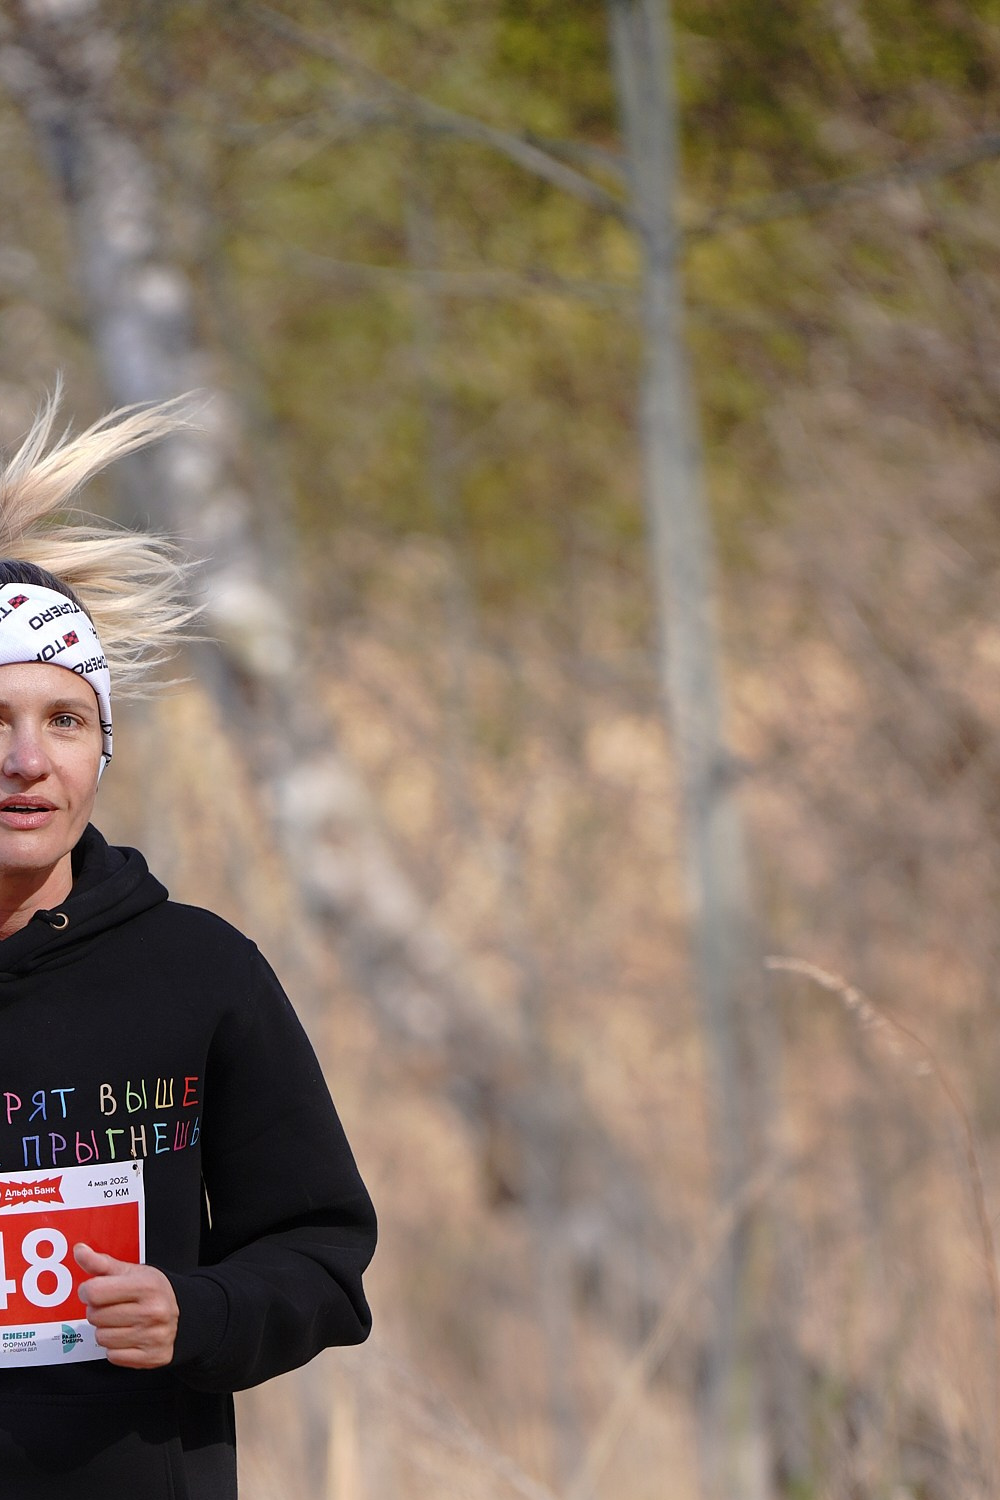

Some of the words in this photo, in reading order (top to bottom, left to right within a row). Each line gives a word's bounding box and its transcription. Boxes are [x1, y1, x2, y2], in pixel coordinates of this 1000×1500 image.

[99, 1076, 200, 1116] ВЫШЕ
[21, 1116, 200, 1168] ПРЫГНЕШЬ
[87, 1180, 94, 1188] 4
[109, 1176, 129, 1185] 2025
[4, 1187, 33, 1200] Альфа
[34, 1186, 56, 1195] Банк
[103, 1190, 113, 1198] 10
[115, 1187, 130, 1197] КМ
[2, 1331, 36, 1340] СИБУР
[2, 1340, 37, 1348] ФОРМУЛА
